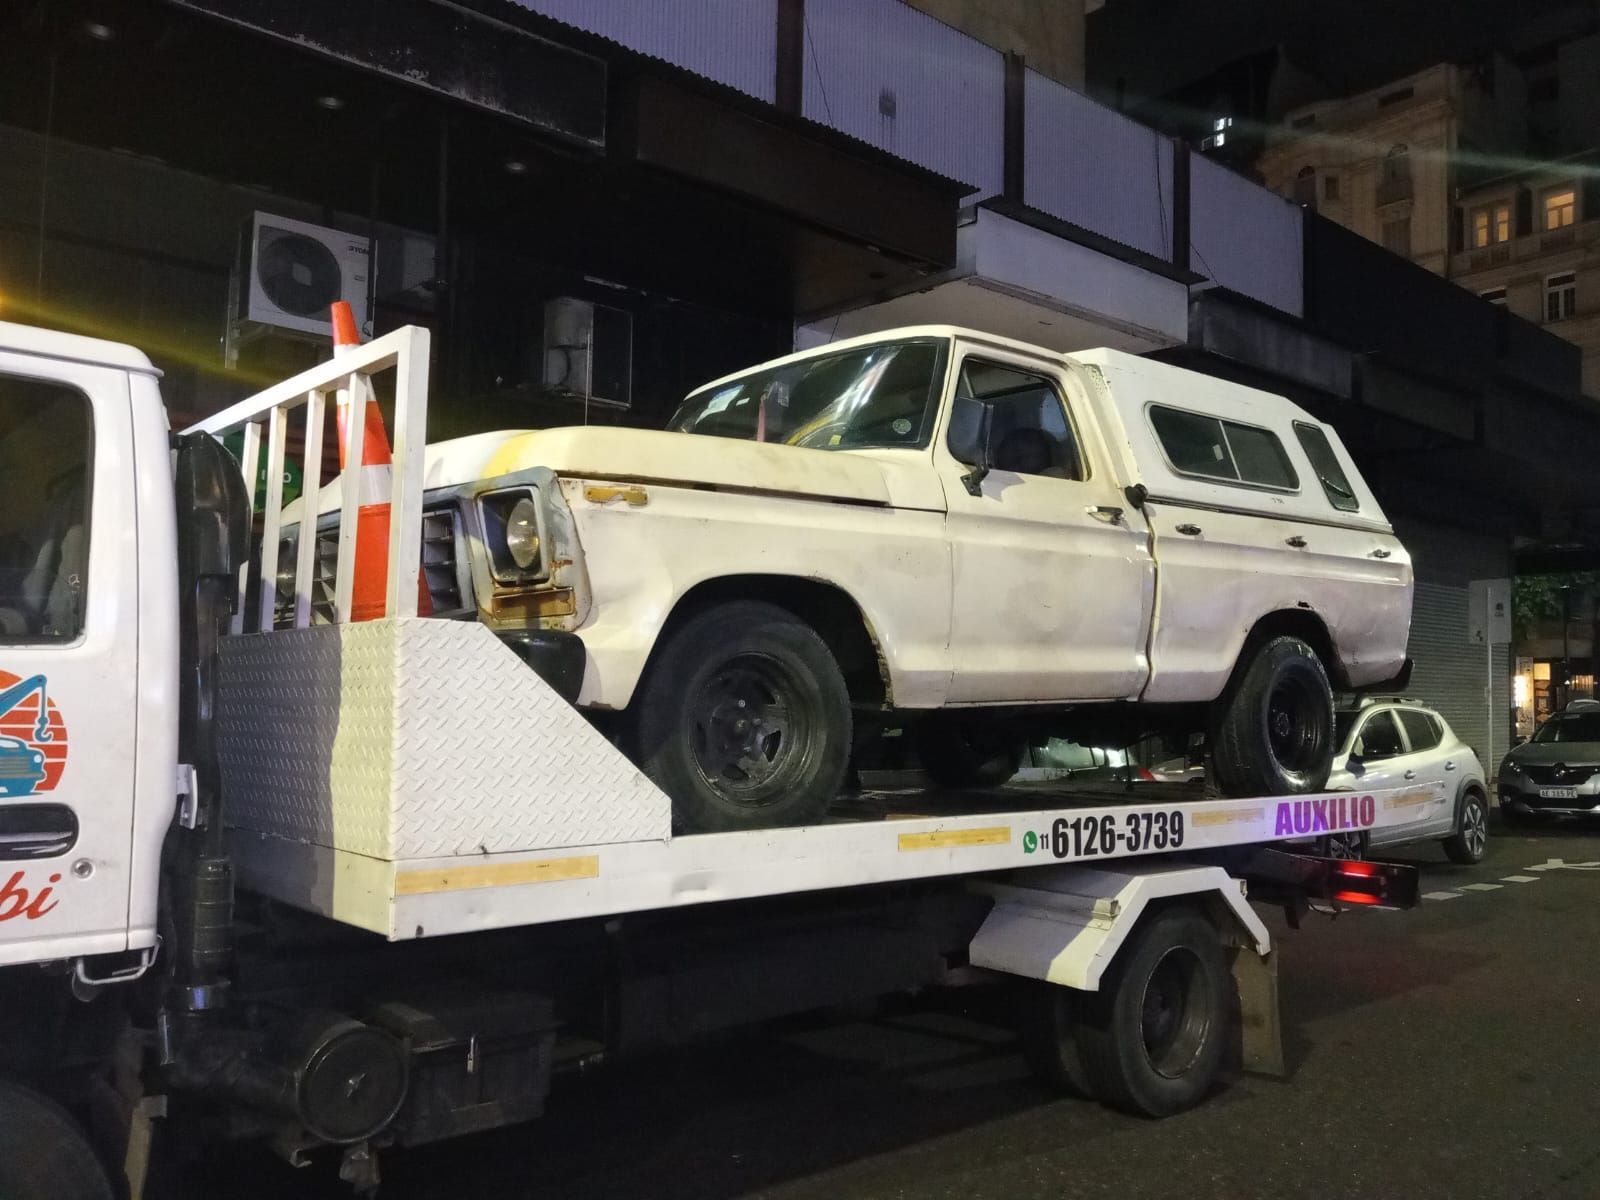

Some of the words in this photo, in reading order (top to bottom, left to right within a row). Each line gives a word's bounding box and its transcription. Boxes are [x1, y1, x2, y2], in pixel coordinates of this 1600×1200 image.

[1040, 833, 1049, 850] 11
[1052, 810, 1184, 859] 6126-3739
[1275, 795, 1376, 836] AUXILIO
